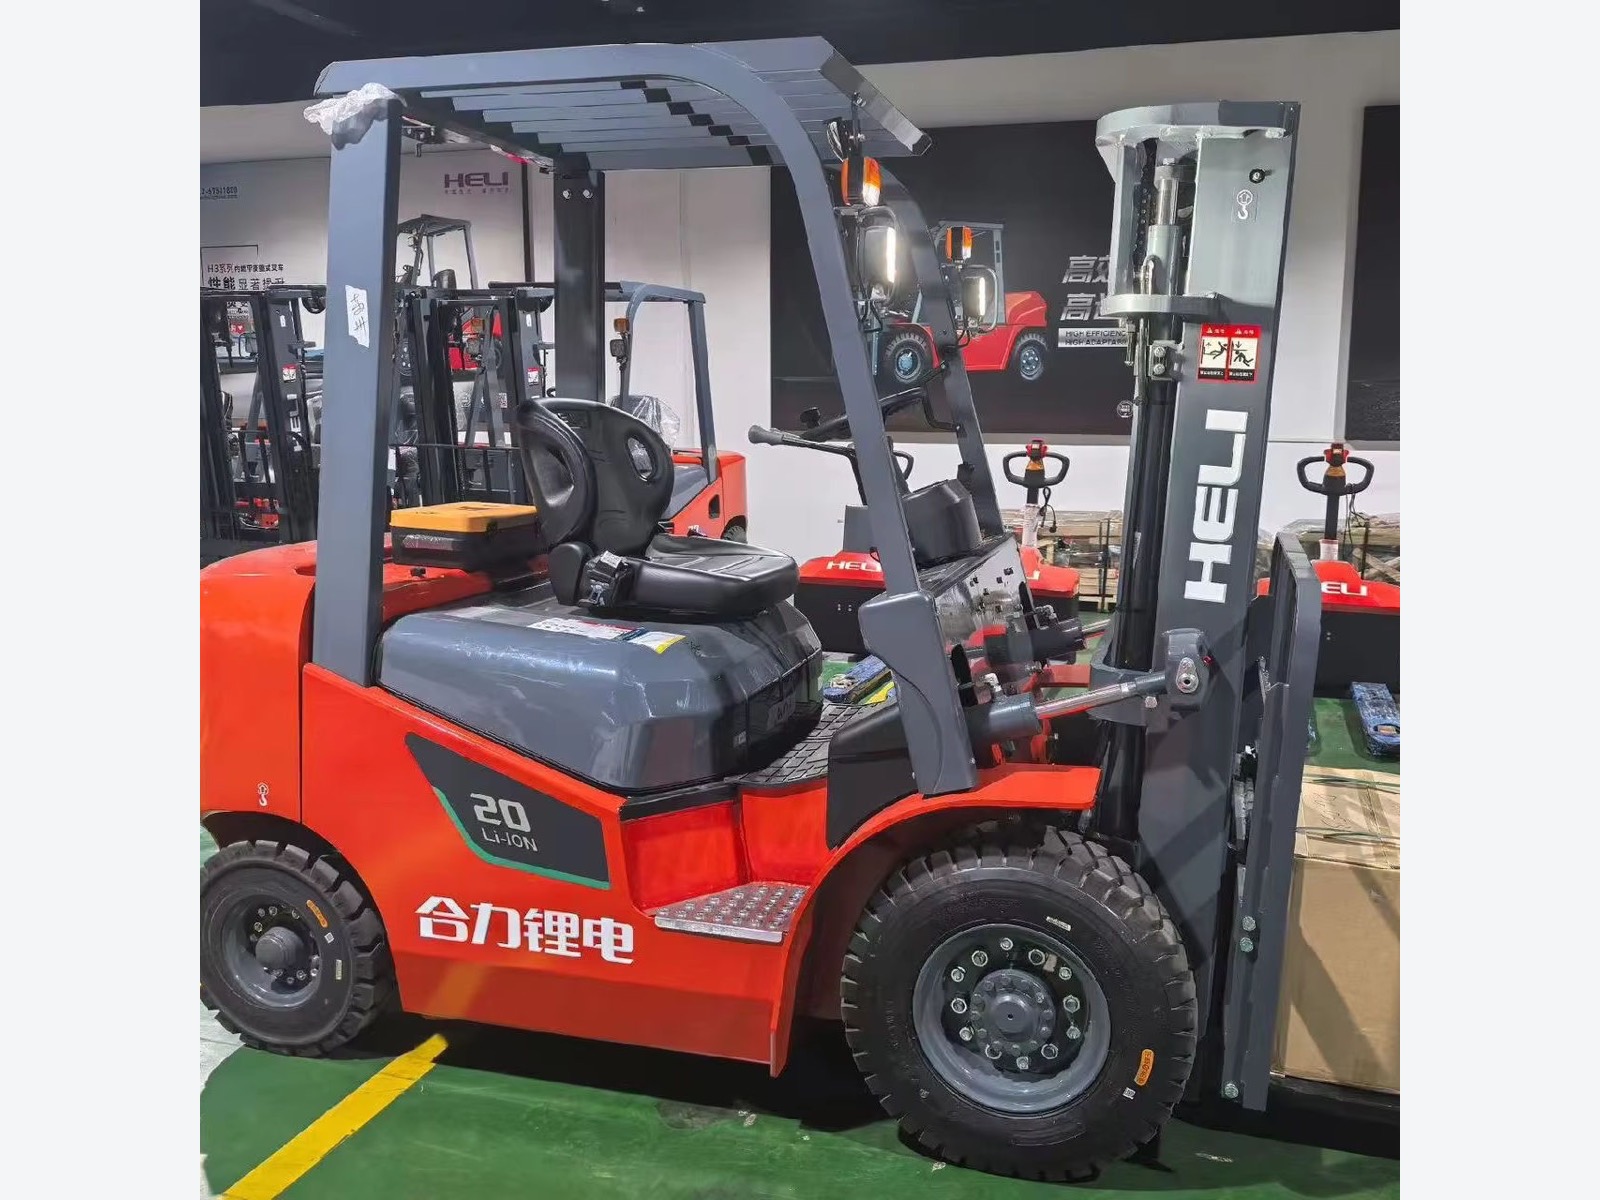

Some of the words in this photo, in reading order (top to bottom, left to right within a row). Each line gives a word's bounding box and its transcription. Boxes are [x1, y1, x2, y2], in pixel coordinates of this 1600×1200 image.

[444, 172, 509, 188] HELI
[1065, 330, 1085, 338] HIGH
[1085, 330, 1127, 338] EFFICIENC
[1184, 409, 1249, 604] HELI
[1321, 581, 1368, 597] ELI
[470, 793, 531, 832] 20
[481, 827, 538, 852] Li-ION
[414, 895, 634, 965] 合力锂电
